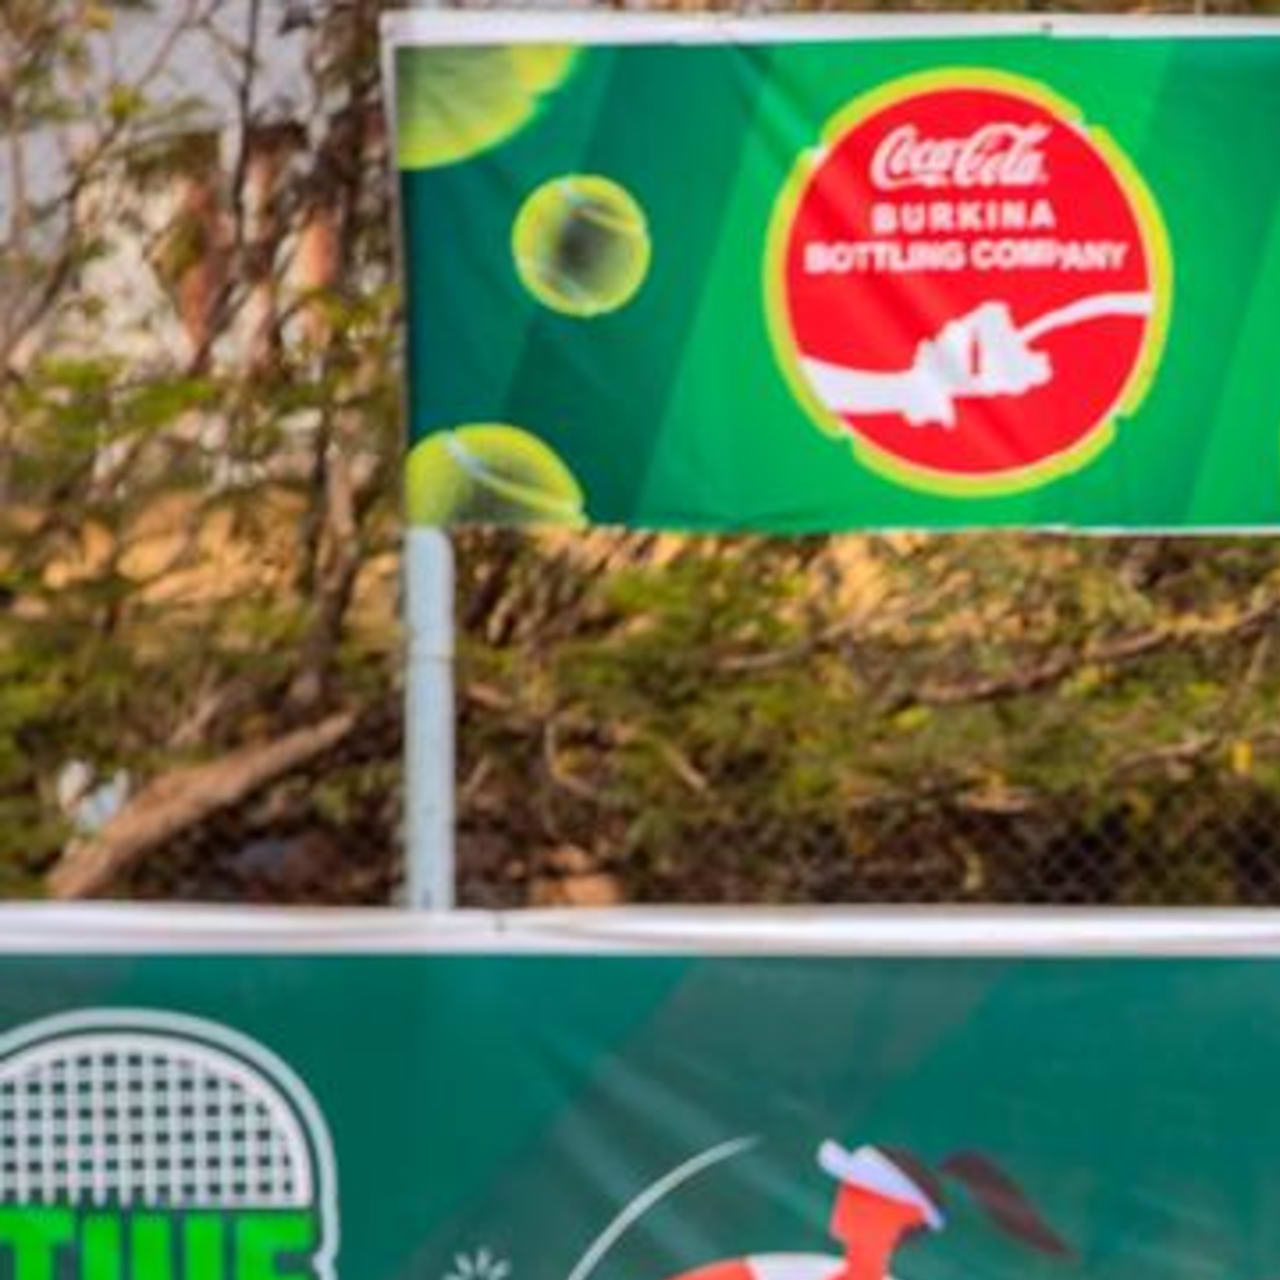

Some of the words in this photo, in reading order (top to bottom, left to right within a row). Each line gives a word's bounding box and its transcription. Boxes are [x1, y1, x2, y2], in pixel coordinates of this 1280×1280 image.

[871, 201, 1053, 232] BURKINA
[804, 242, 964, 272] BOTTLING
[970, 239, 1127, 270] COMPANY
